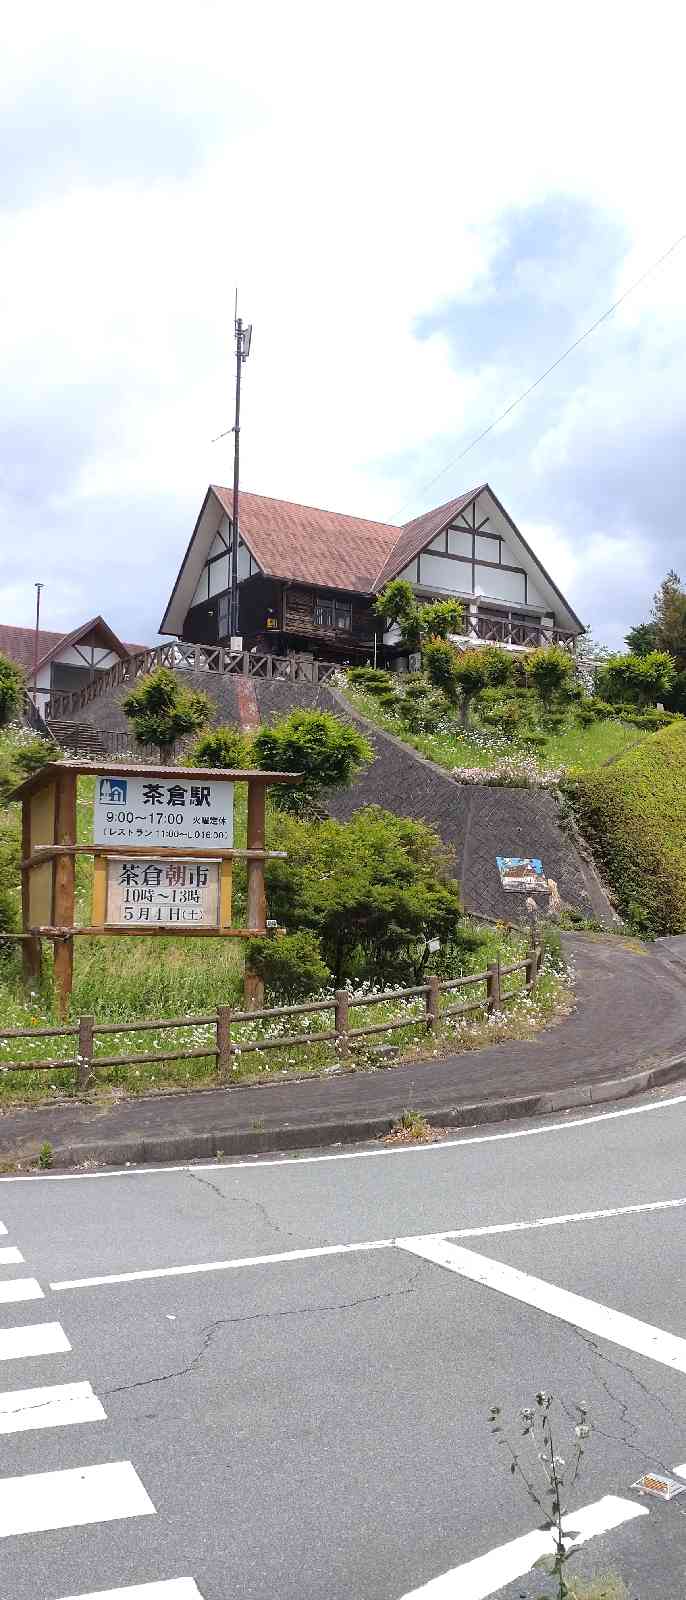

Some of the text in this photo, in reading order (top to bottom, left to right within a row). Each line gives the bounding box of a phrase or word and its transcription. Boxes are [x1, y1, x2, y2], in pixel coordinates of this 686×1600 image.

[142, 784, 211, 807] 茶倉駅
[119, 864, 209, 887] 茶倉朝市
